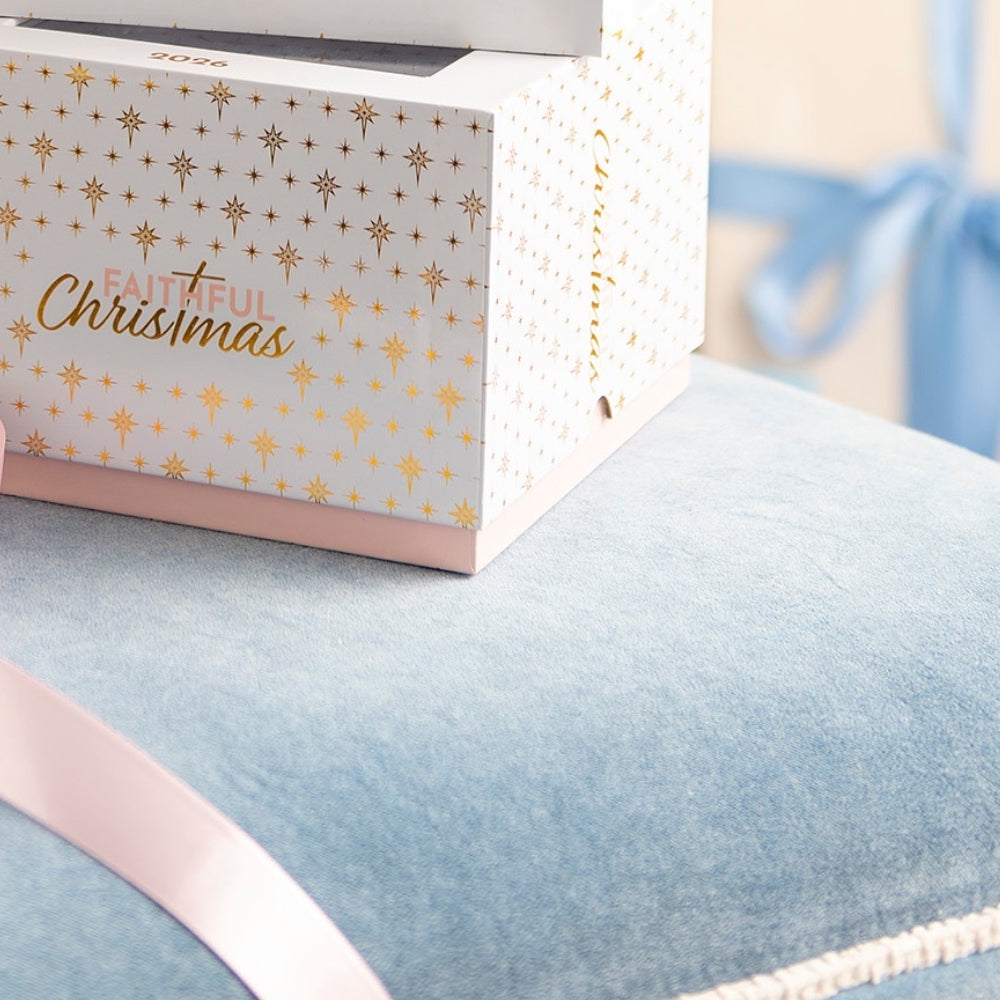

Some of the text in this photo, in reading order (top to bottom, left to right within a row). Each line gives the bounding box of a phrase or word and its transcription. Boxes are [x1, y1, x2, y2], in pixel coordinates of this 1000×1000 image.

[148, 52, 229, 68] 2026
[103, 267, 276, 322] FAITHFUL
[590, 129, 616, 393] Christmas
[36, 260, 295, 358] Christmas
